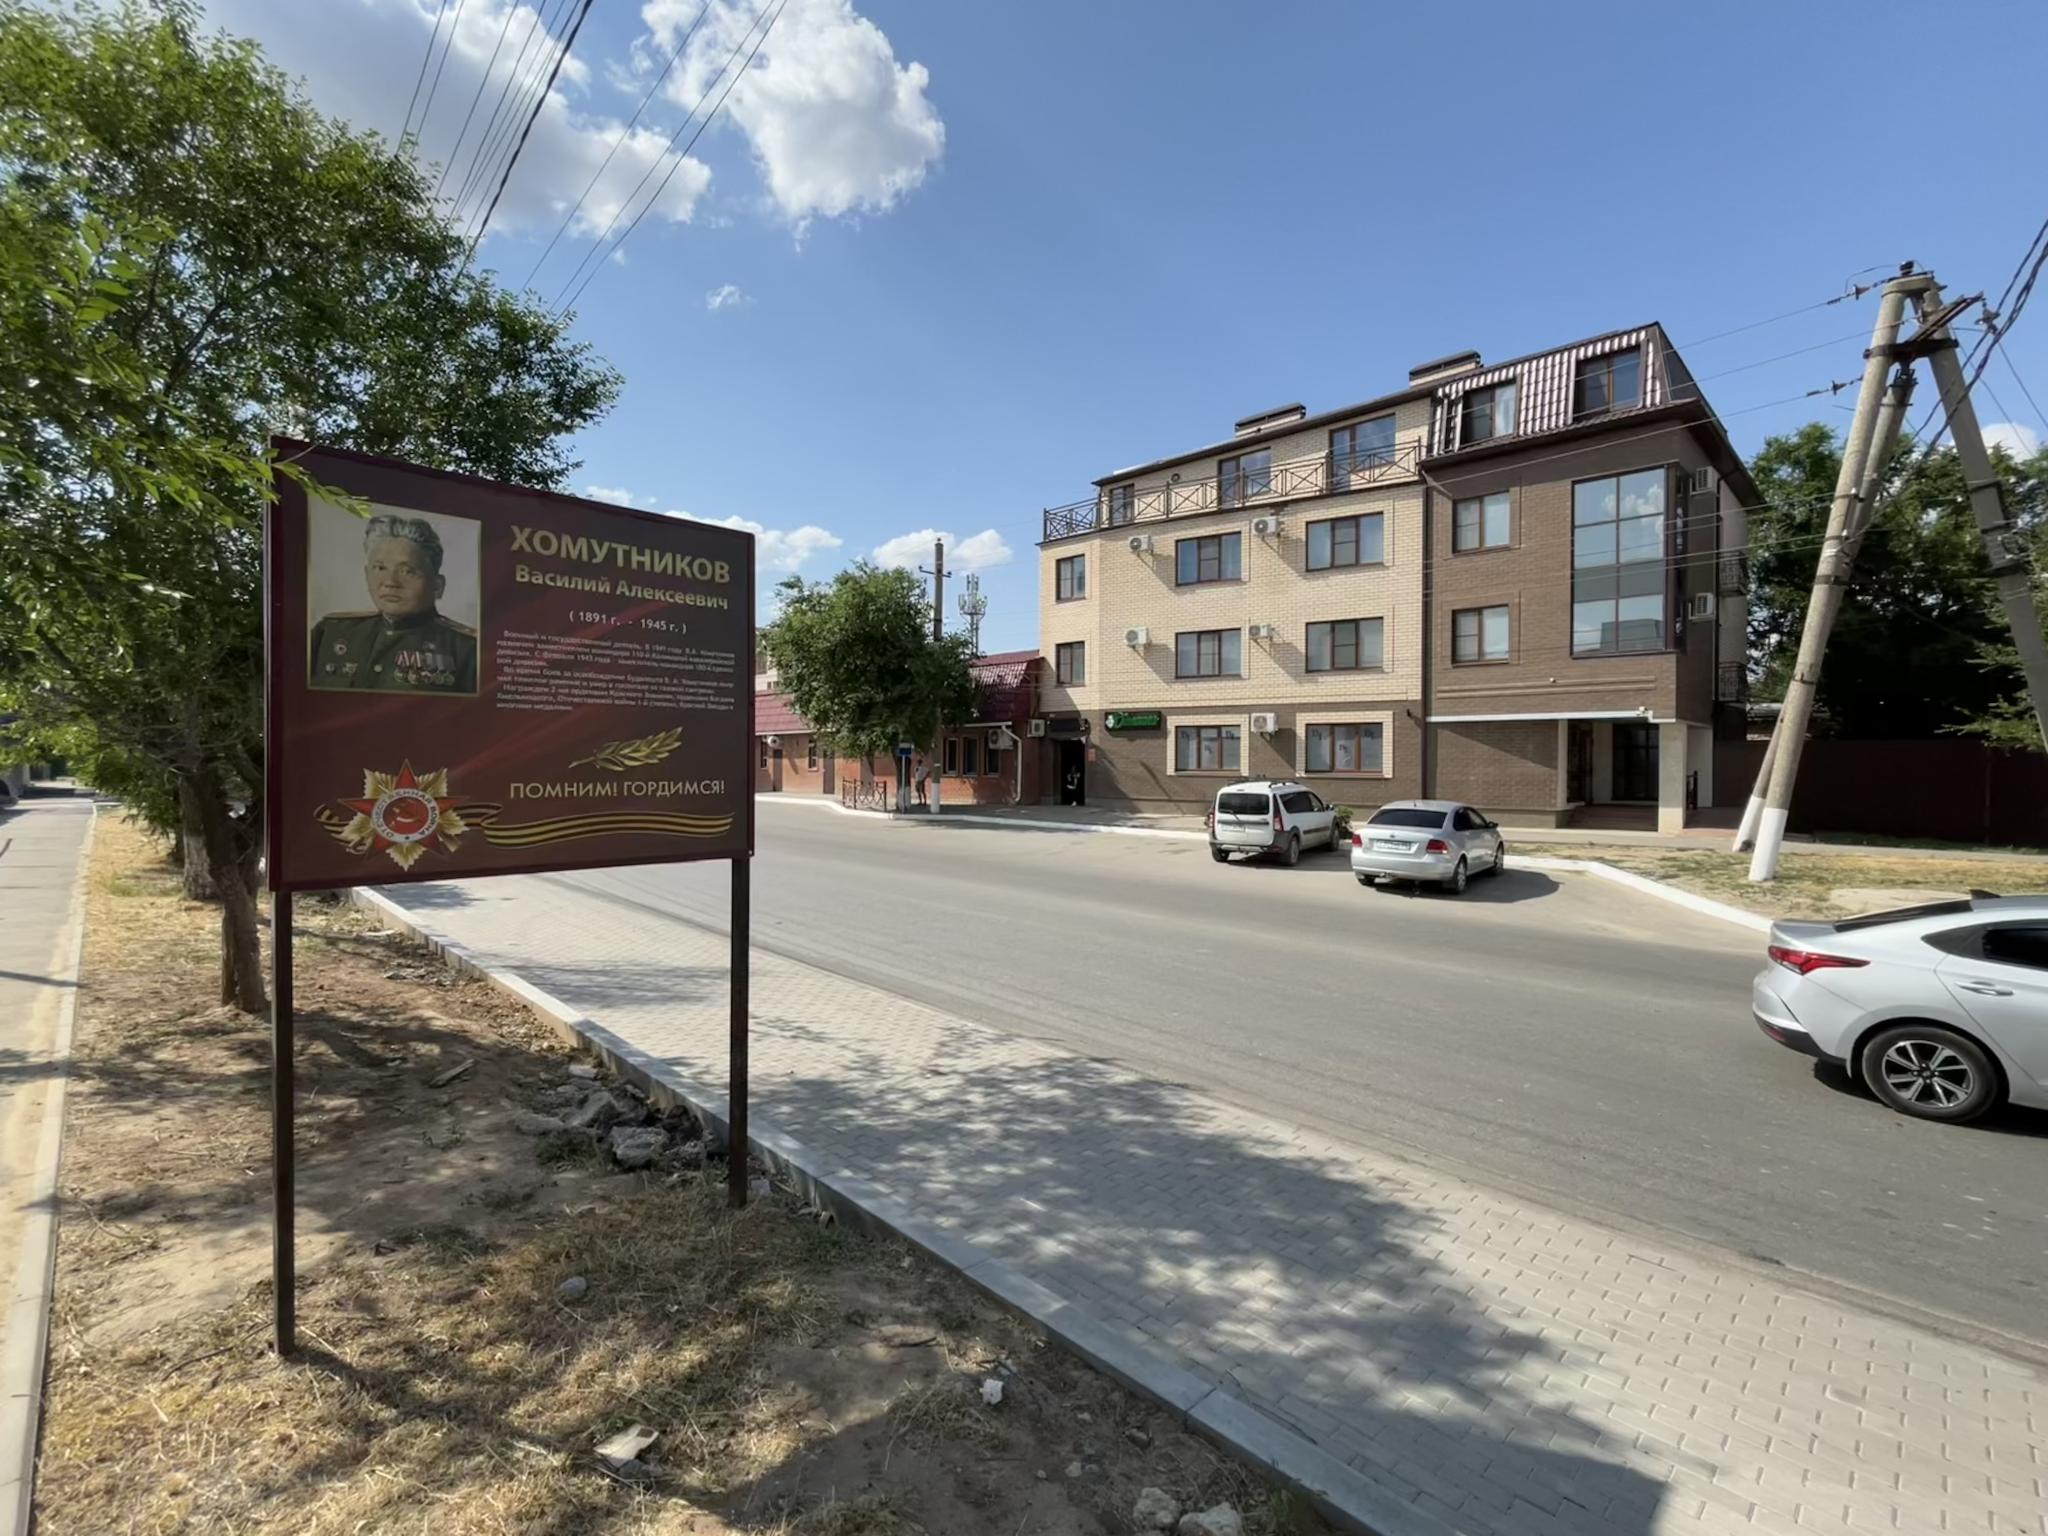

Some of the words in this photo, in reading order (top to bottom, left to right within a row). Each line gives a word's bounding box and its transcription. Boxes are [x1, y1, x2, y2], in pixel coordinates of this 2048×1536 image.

[510, 525, 730, 584] ХОМУТНИКОВ
[515, 564, 610, 594] Василий
[616, 579, 728, 610] Алексеевич
[579, 611, 607, 625] 1891
[641, 618, 666, 632] 1945
[510, 781, 618, 799] ПОМНИМ!
[623, 780, 725, 798] ГОРДИМСЯ!
